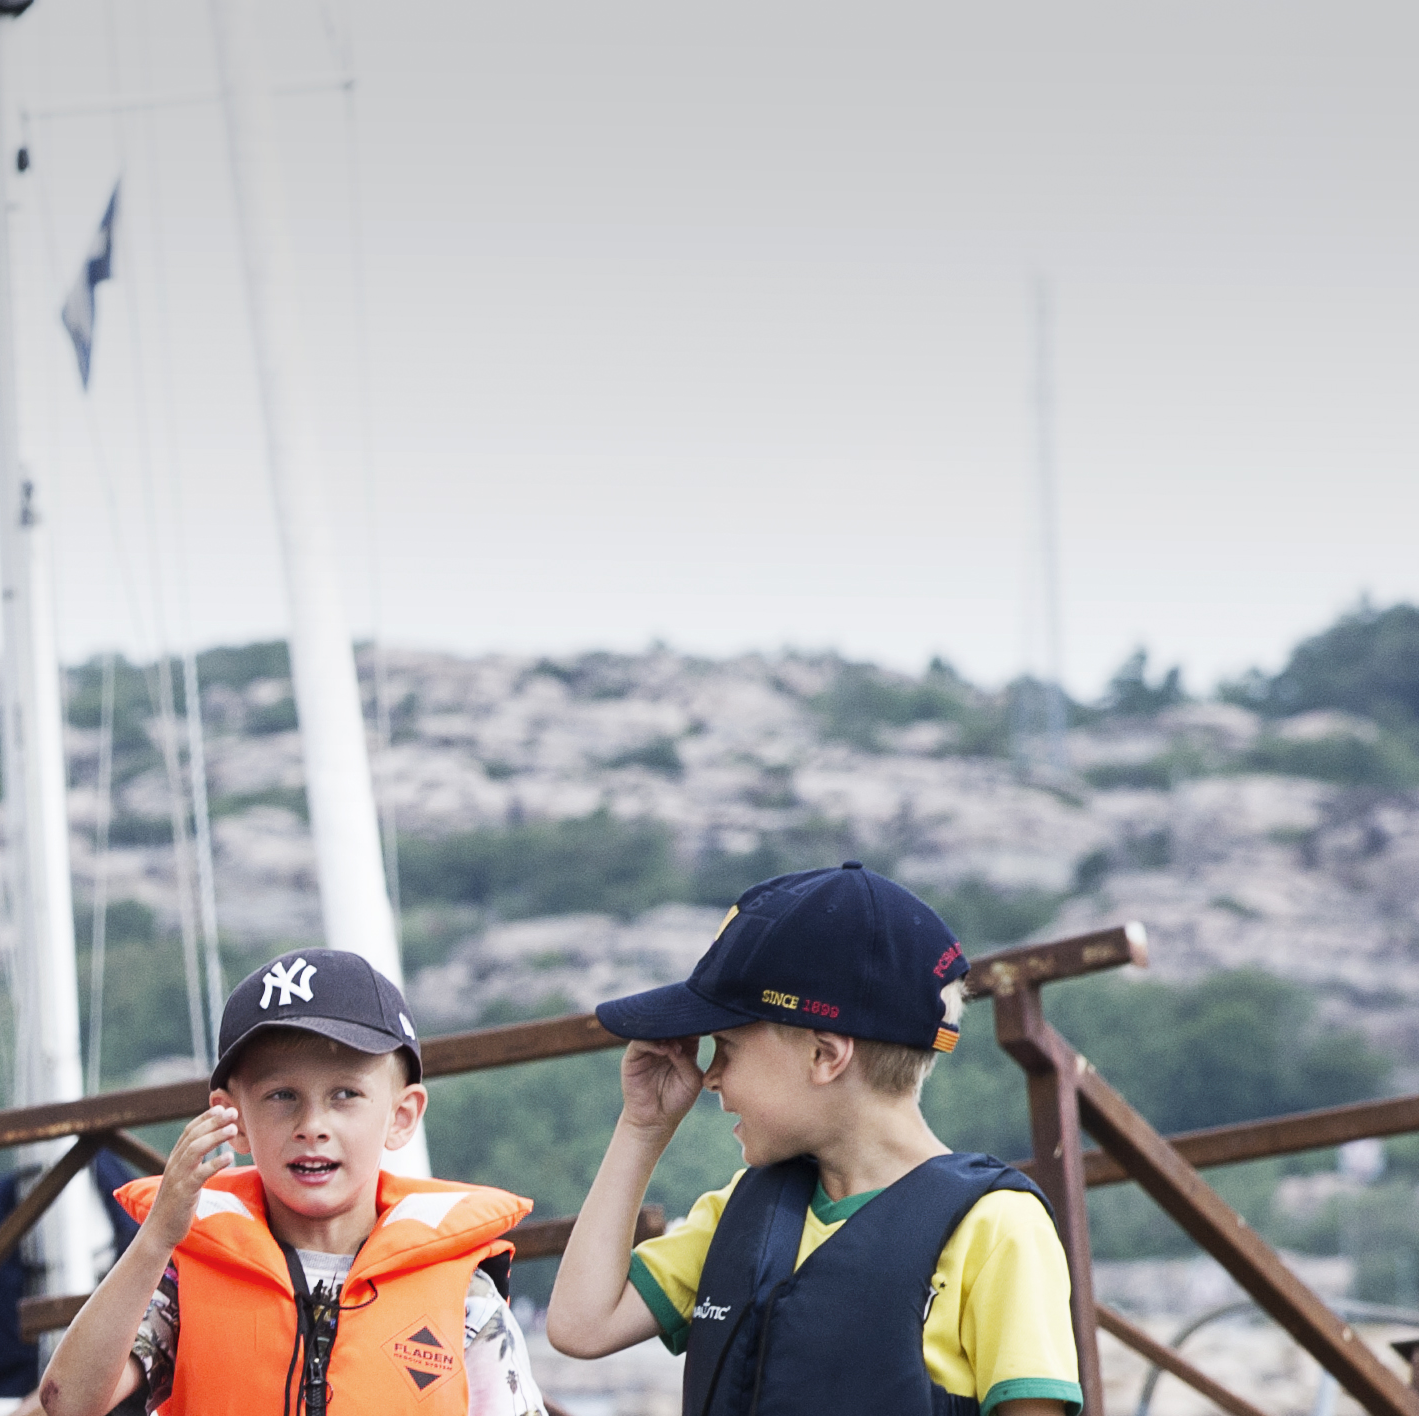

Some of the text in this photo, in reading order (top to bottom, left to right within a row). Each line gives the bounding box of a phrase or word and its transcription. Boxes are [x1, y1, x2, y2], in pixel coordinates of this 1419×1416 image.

[761, 989, 840, 1019] SINCE 1899
[393, 1343, 454, 1365] FLADEN
